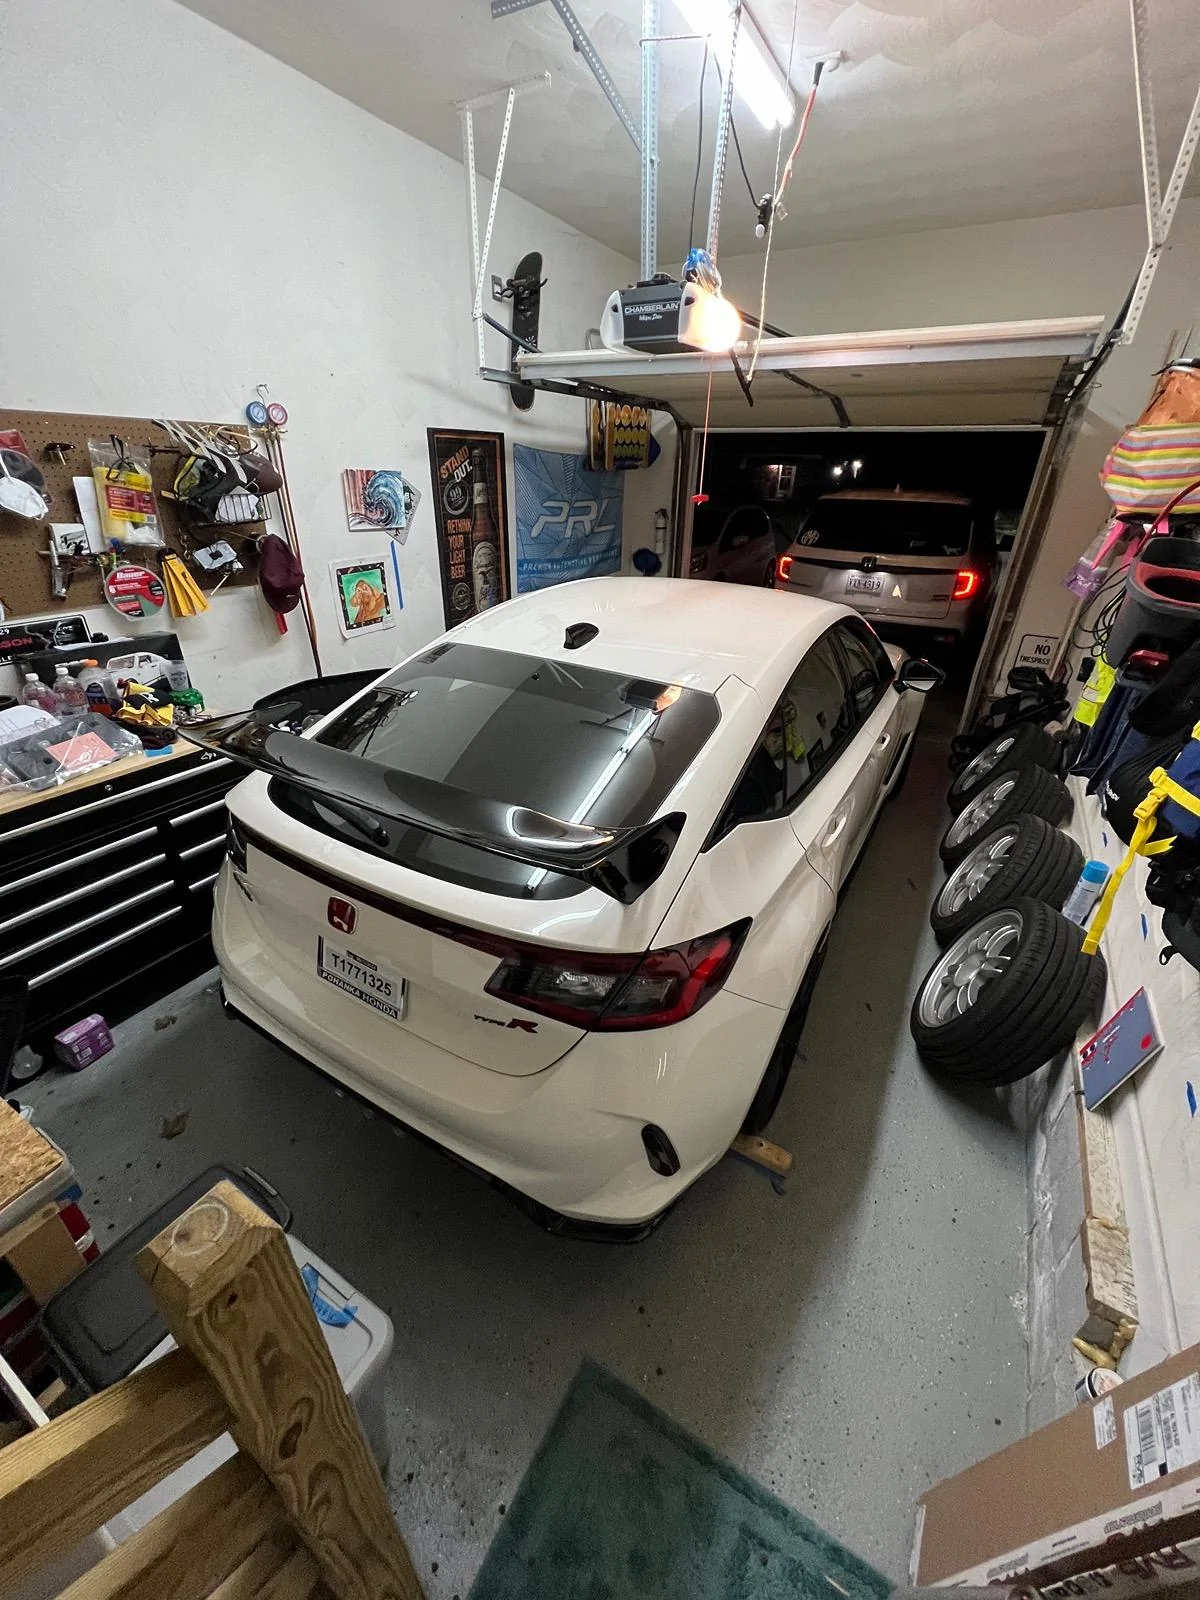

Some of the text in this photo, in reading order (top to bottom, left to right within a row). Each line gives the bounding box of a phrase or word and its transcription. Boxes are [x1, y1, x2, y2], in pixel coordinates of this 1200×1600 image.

[625, 302, 679, 314] CHAMBERLAIN
[440, 446, 469, 479] STAND
[454, 459, 473, 482] OUT.
[447, 518, 472, 534] RETHINK
[530, 498, 616, 538] PRL
[448, 534, 465, 550] YOUR
[449, 549, 466, 564] LIGHT
[450, 564, 466, 579] BEER
[1034, 644, 1050, 656] NO
[331, 952, 392, 997] T1771325
[322, 971, 398, 1018] POHANKA HONDA
[506, 1018, 539, 1034] R
